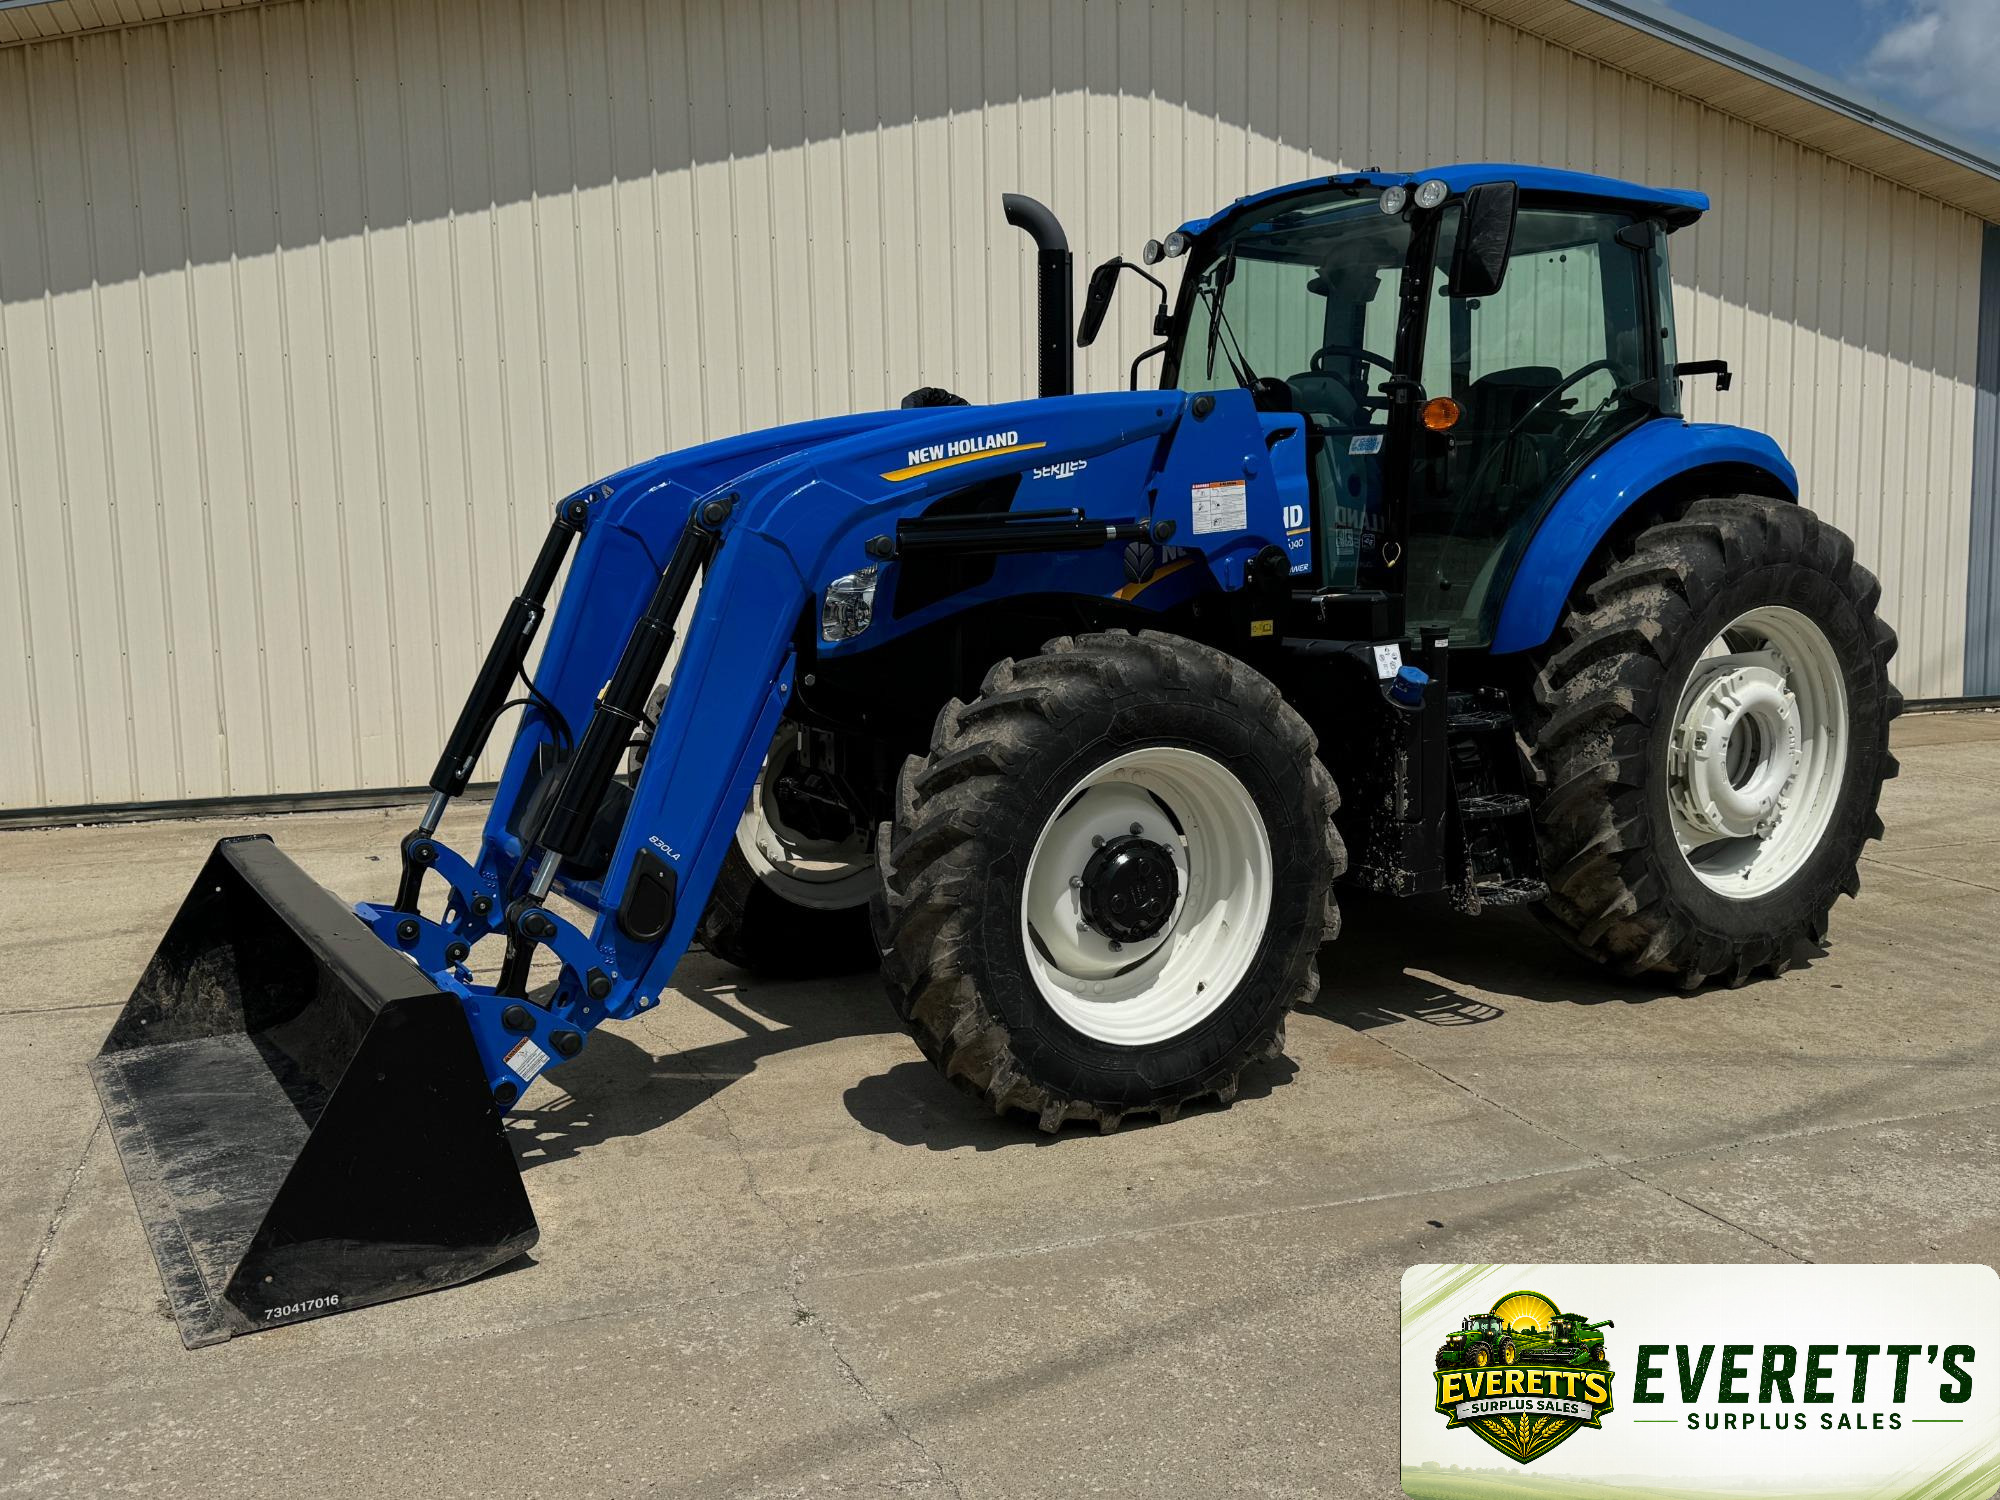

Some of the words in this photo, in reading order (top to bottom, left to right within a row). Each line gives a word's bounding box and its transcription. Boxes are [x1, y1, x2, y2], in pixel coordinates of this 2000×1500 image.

[908, 444, 944, 466] NEW
[948, 430, 1019, 457] HOLLAND
[649, 835, 681, 861] 830LA
[264, 1294, 340, 1321] 730417016
